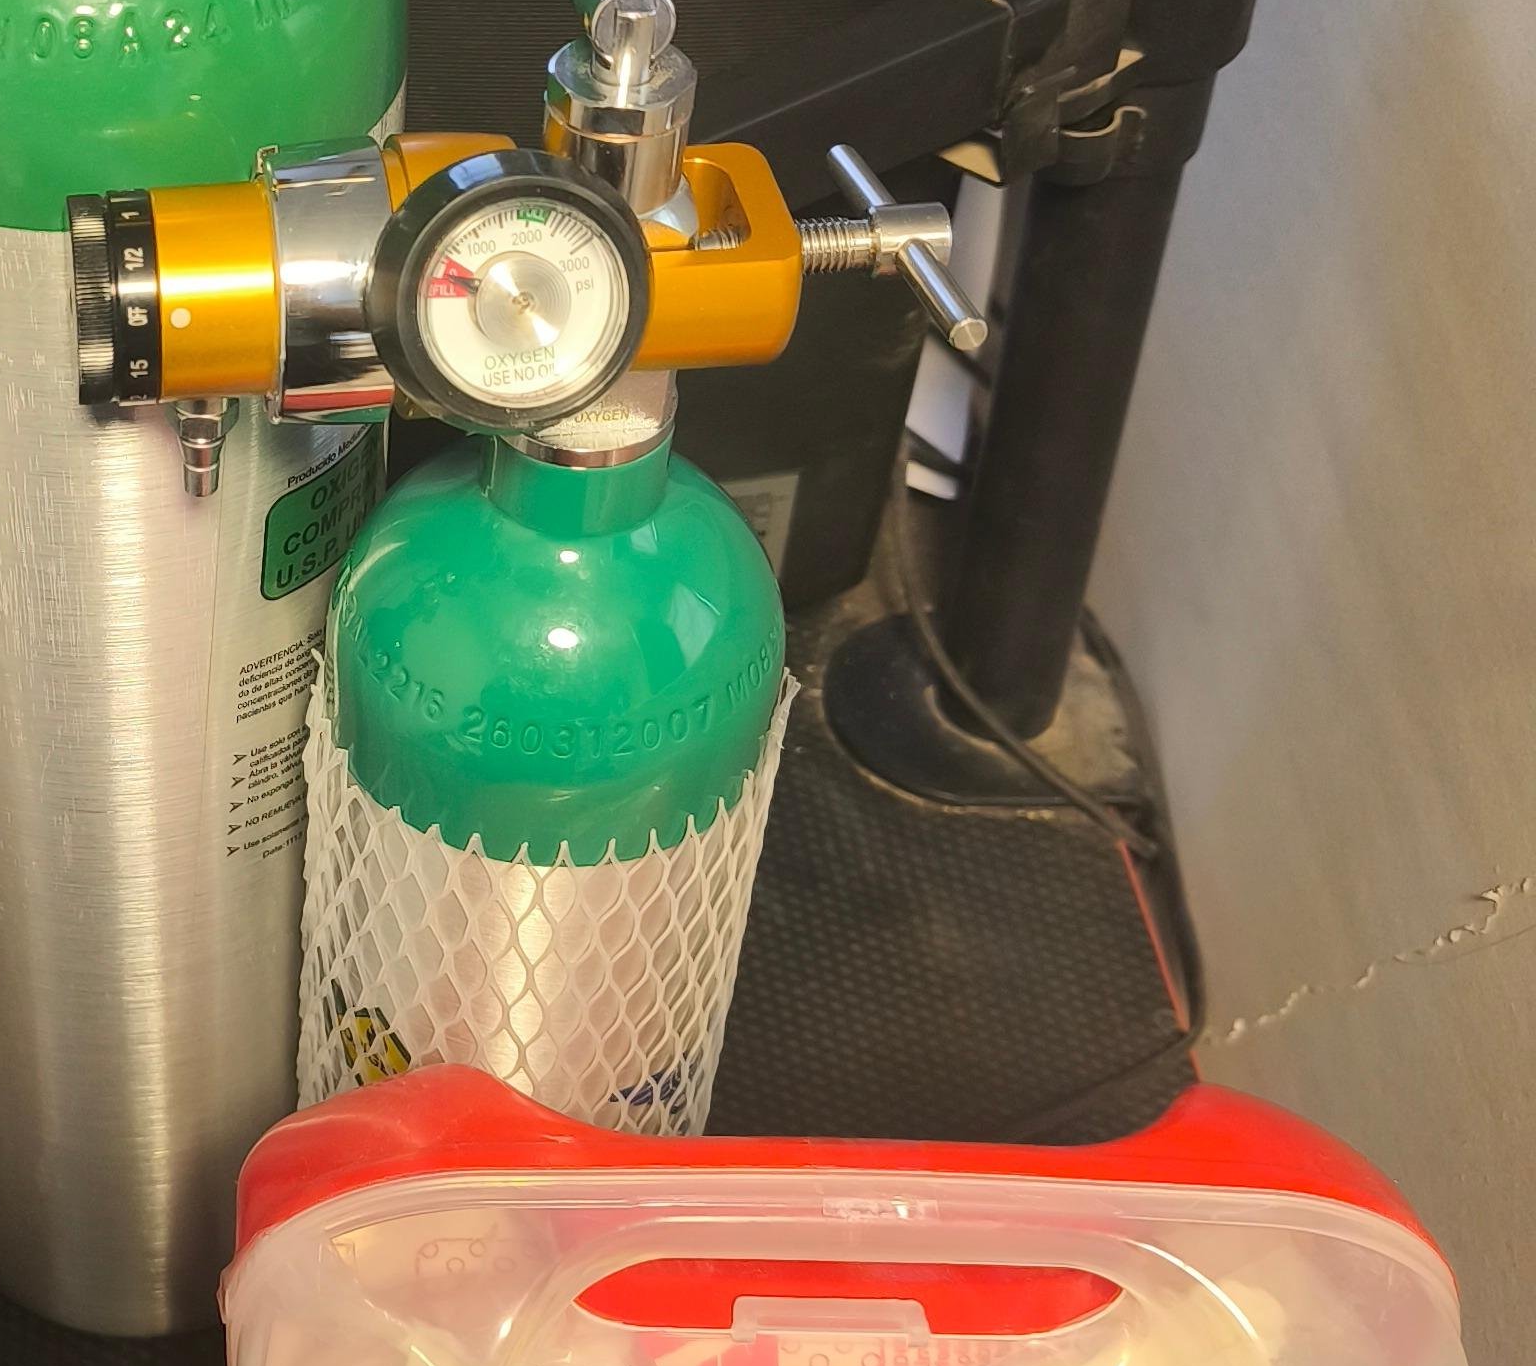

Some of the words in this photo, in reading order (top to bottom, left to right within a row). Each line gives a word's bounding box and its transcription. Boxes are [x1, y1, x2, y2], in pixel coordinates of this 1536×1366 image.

[123, 246, 145, 272] 1/2
[467, 239, 498, 257] 1000
[511, 228, 544, 247] 2000
[558, 256, 591, 275] 3000
[575, 278, 595, 295] psi
[127, 306, 149, 327] OFF
[130, 358, 150, 379] 15
[484, 346, 556, 371] OXYGEN
[482, 368, 512, 388] USE
[513, 366, 535, 385] NO
[287, 451, 337, 489] Producido
